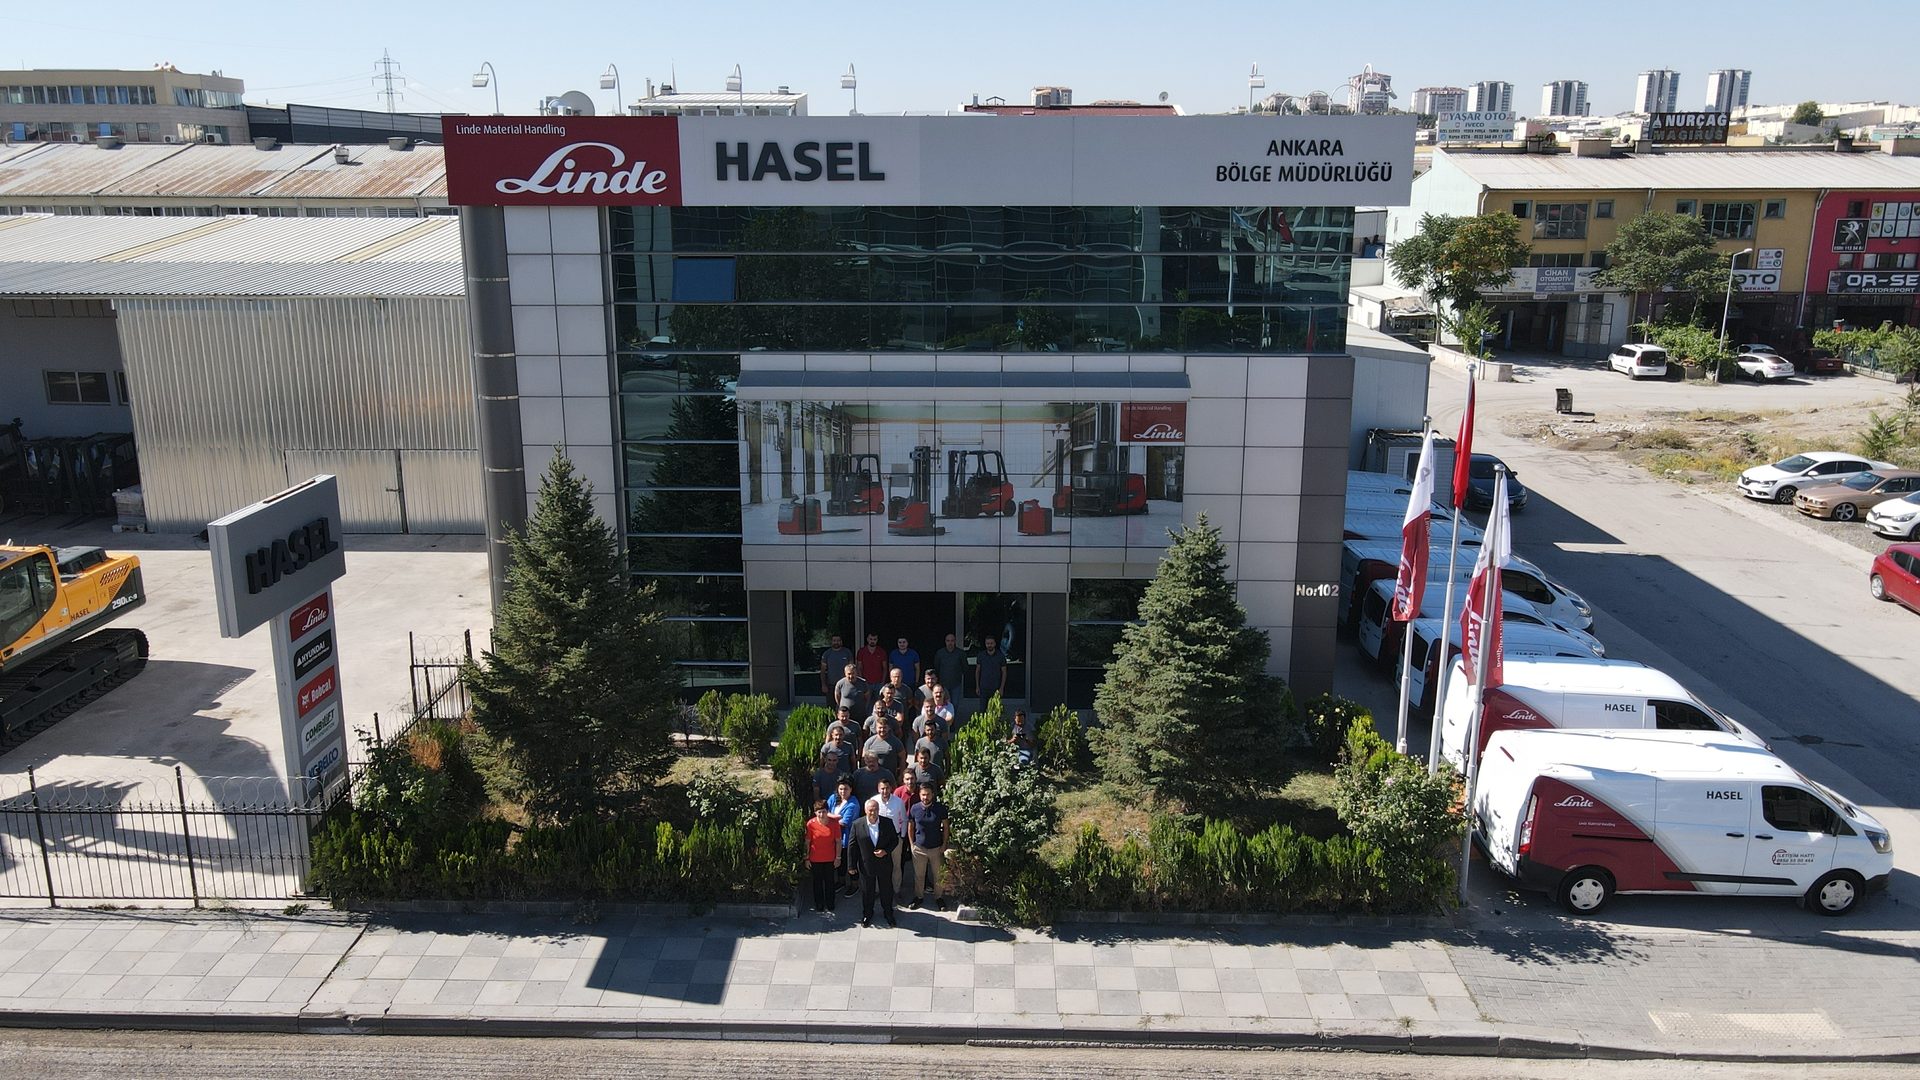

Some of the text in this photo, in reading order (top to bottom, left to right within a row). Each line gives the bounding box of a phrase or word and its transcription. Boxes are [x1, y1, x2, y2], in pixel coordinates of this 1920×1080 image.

[1449, 113, 1480, 122] YAŞAR
[1665, 112, 1727, 129] NURÇAĞ
[456, 124, 566, 137] Linde Material Handling
[1266, 139, 1344, 156] ANKARA
[495, 142, 668, 194] Linde
[715, 141, 885, 182] HASEL
[1216, 162, 1392, 182] BÖLGE MÜDÜRLÜĞÜ
[1133, 423, 1183, 439] Linde
[245, 517, 338, 594] HASEL
[1296, 584, 1339, 597] No:102
[70, 608, 90, 621] HASEL
[302, 608, 327, 631] Linde
[301, 641, 325, 665] HYUNDAI
[311, 679, 331, 703] Bobcat
[1502, 709, 1537, 720] Linde
[1604, 703, 1637, 713] HASEL
[1553, 795, 1594, 807] Linde
[1706, 791, 1743, 800] HASEL
